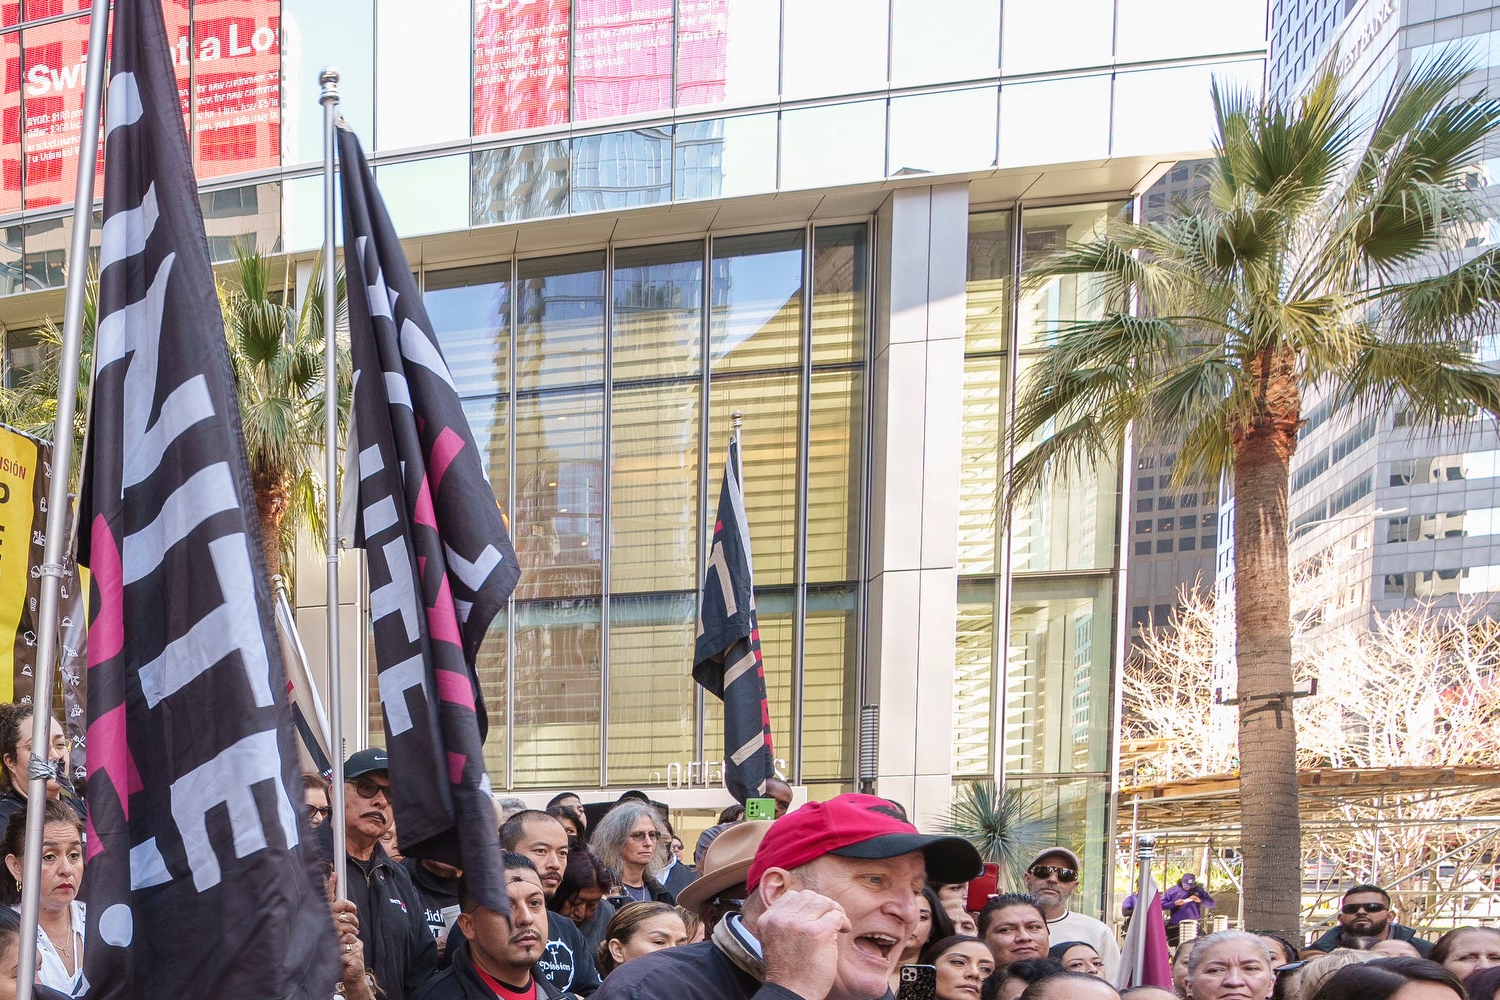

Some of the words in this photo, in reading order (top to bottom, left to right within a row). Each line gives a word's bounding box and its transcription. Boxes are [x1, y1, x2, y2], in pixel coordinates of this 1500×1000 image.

[201, 36, 221, 62] a
[228, 23, 279, 57] Lo
[27, 55, 87, 96] Swi
[667, 758, 787, 790] OFFIS
